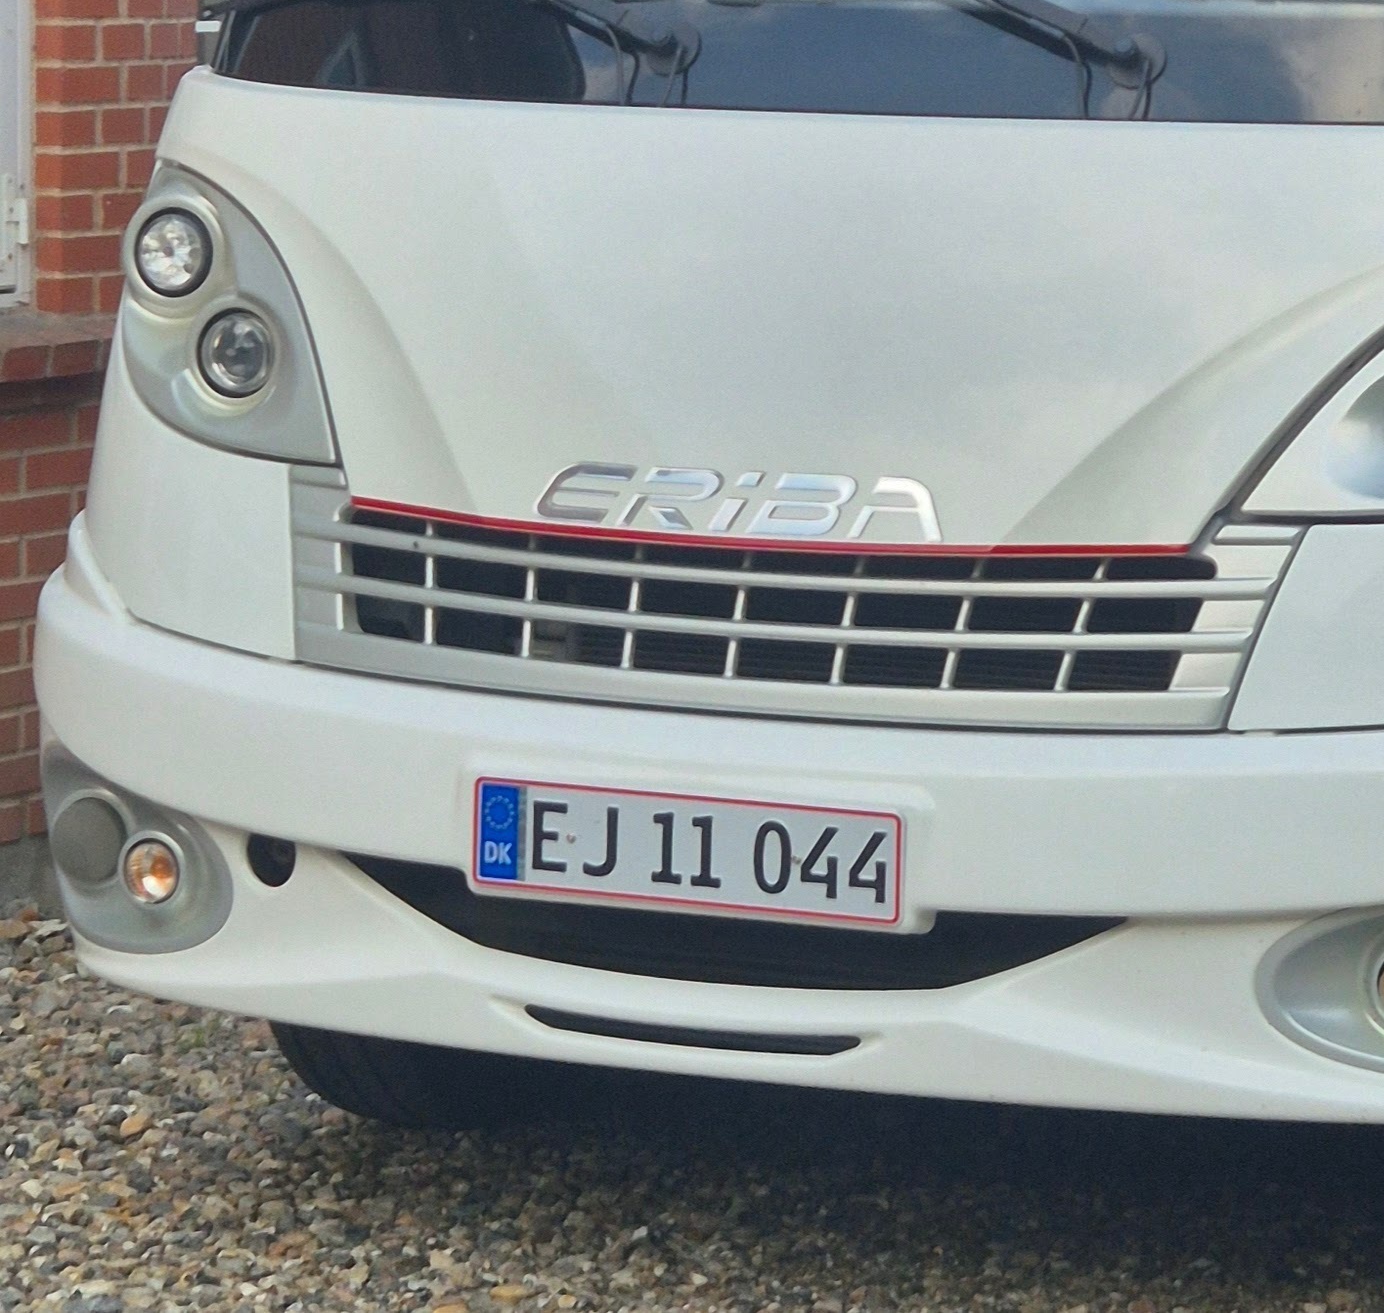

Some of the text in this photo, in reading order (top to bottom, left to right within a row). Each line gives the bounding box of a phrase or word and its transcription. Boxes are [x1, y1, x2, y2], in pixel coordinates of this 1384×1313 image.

[484, 840, 513, 865] DK
[531, 799, 889, 905] EJ 11 044
